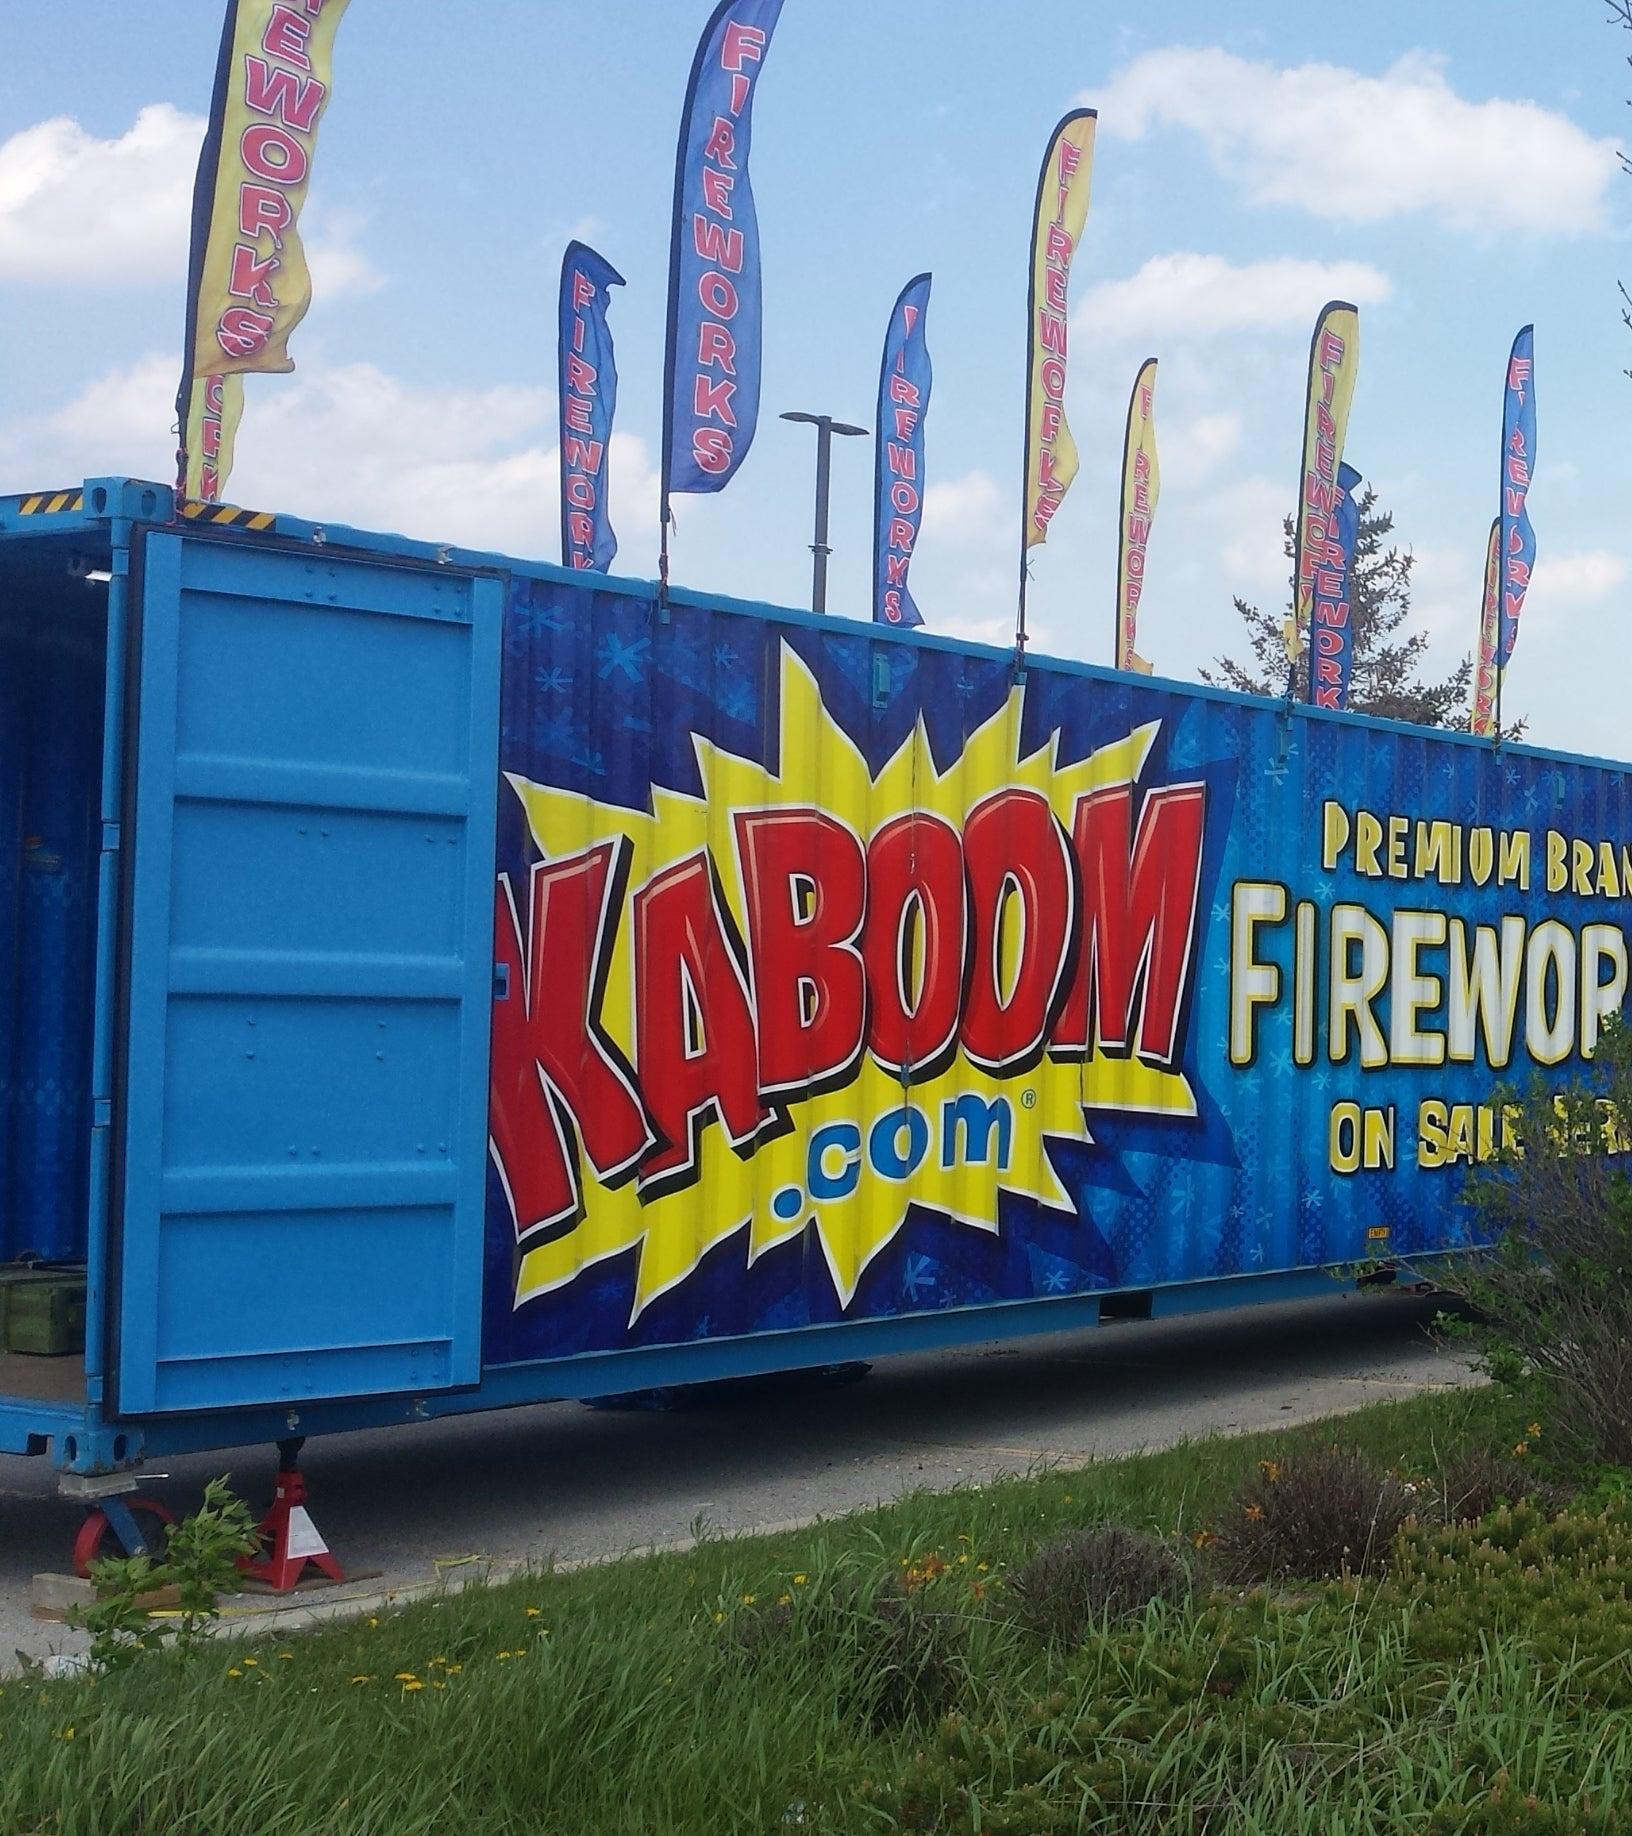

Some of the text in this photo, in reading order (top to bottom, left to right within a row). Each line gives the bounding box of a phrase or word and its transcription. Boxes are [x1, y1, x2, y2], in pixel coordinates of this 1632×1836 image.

[216, 0, 325, 358] EWORKS
[691, 20, 766, 475] FIREWORKS
[490, 780, 1206, 1250] KABOOM
[1322, 800, 1531, 892] PREMIUM
[1329, 1100, 1395, 1175] ON
